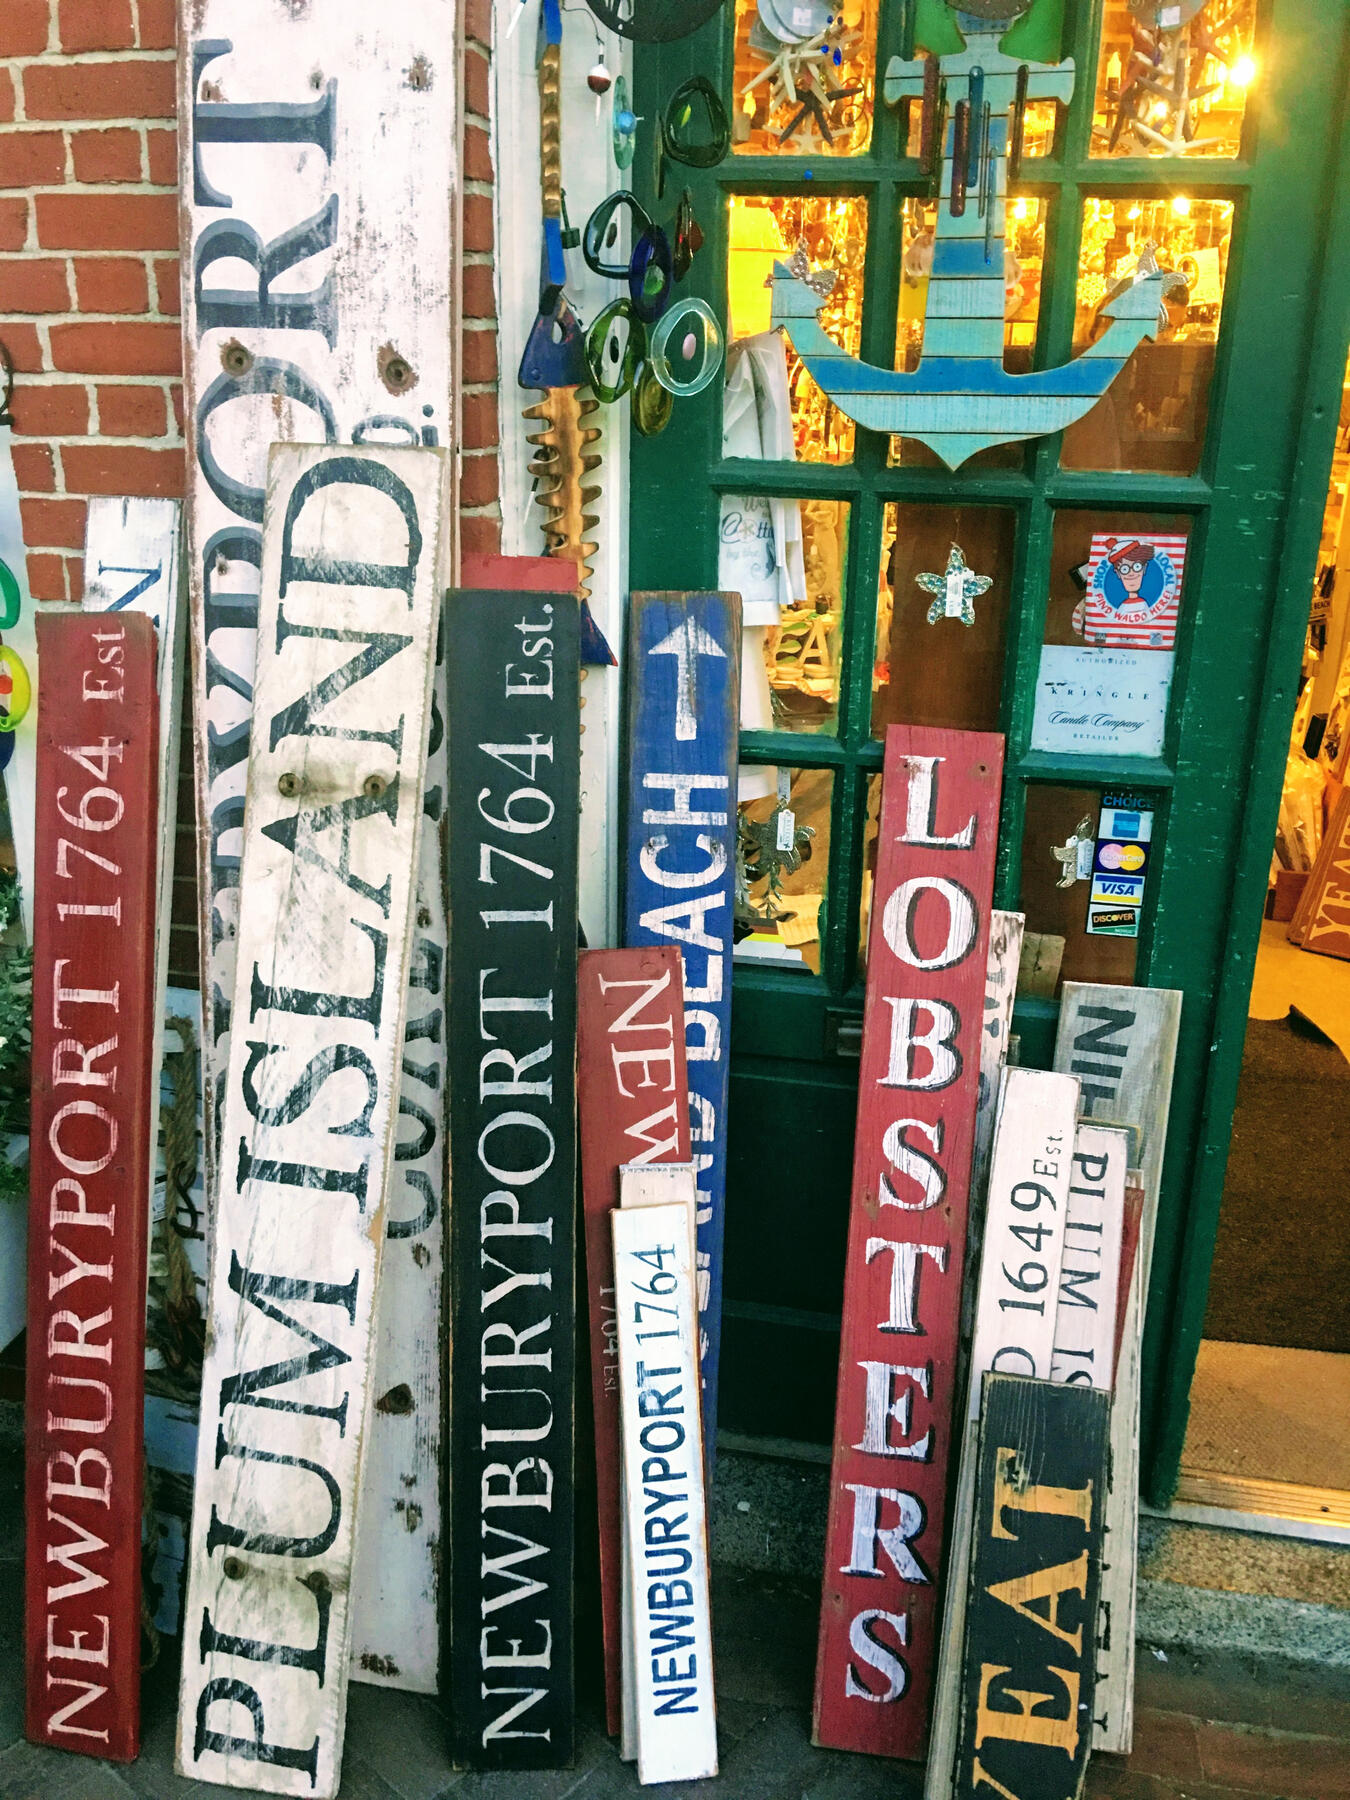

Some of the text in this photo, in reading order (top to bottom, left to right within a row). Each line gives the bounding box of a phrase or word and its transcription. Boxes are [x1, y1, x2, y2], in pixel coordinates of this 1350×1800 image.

[1093, 560, 1110, 589] SHOP
[1155, 552, 1175, 586] LOCAL
[1095, 590, 1173, 623] FIND WALDO HERE!
[1076, 657, 1137, 666] AUTHORIZED
[1051, 687, 1150, 700] KRINGLE
[1048, 711, 1145, 733] Candle Company
[1073, 733, 1119, 741] RETAILER
[236, 456, 423, 1215] ISLAND
[1101, 883, 1135, 896] VISA
[1093, 913, 1134, 924] DISCOVER
[46, 625, 127, 1745] NEWBURYPORT 1764 Est
[479, 602, 555, 1750] NEWBURYPORT 1764 Est.
[839, 756, 979, 1703] LOBSTERS
[998, 1181, 1057, 1317] 1649
[1033, 1129, 1064, 1180] Est.
[630, 1243, 699, 1717] NEWBURYPORT 1764
[194, 1249, 361, 1790] PLUM
